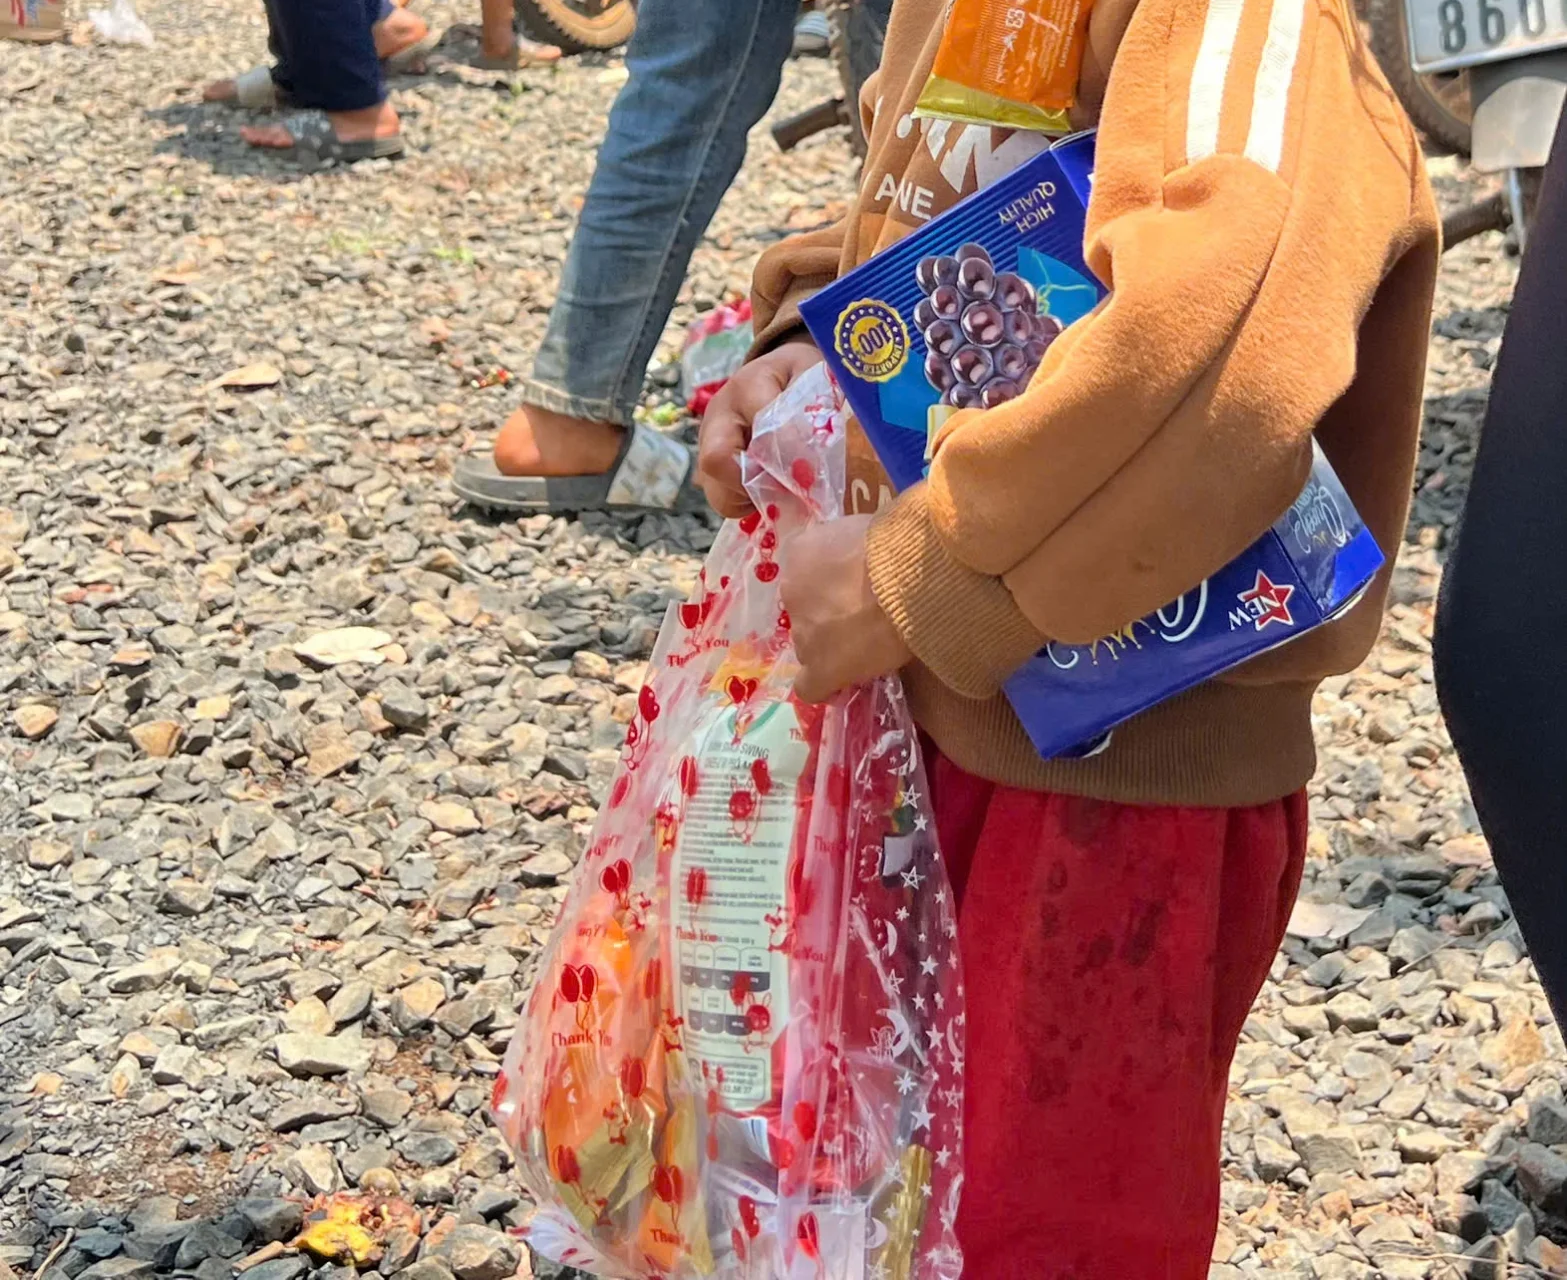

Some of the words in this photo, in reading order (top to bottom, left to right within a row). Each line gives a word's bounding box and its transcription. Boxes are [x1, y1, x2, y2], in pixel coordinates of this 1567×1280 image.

[998, 181, 1056, 225] QUALITY
[1016, 202, 1055, 233] HIGH
[862, 344, 902, 375] IMPORTED
[1228, 589, 1281, 631] NEW
